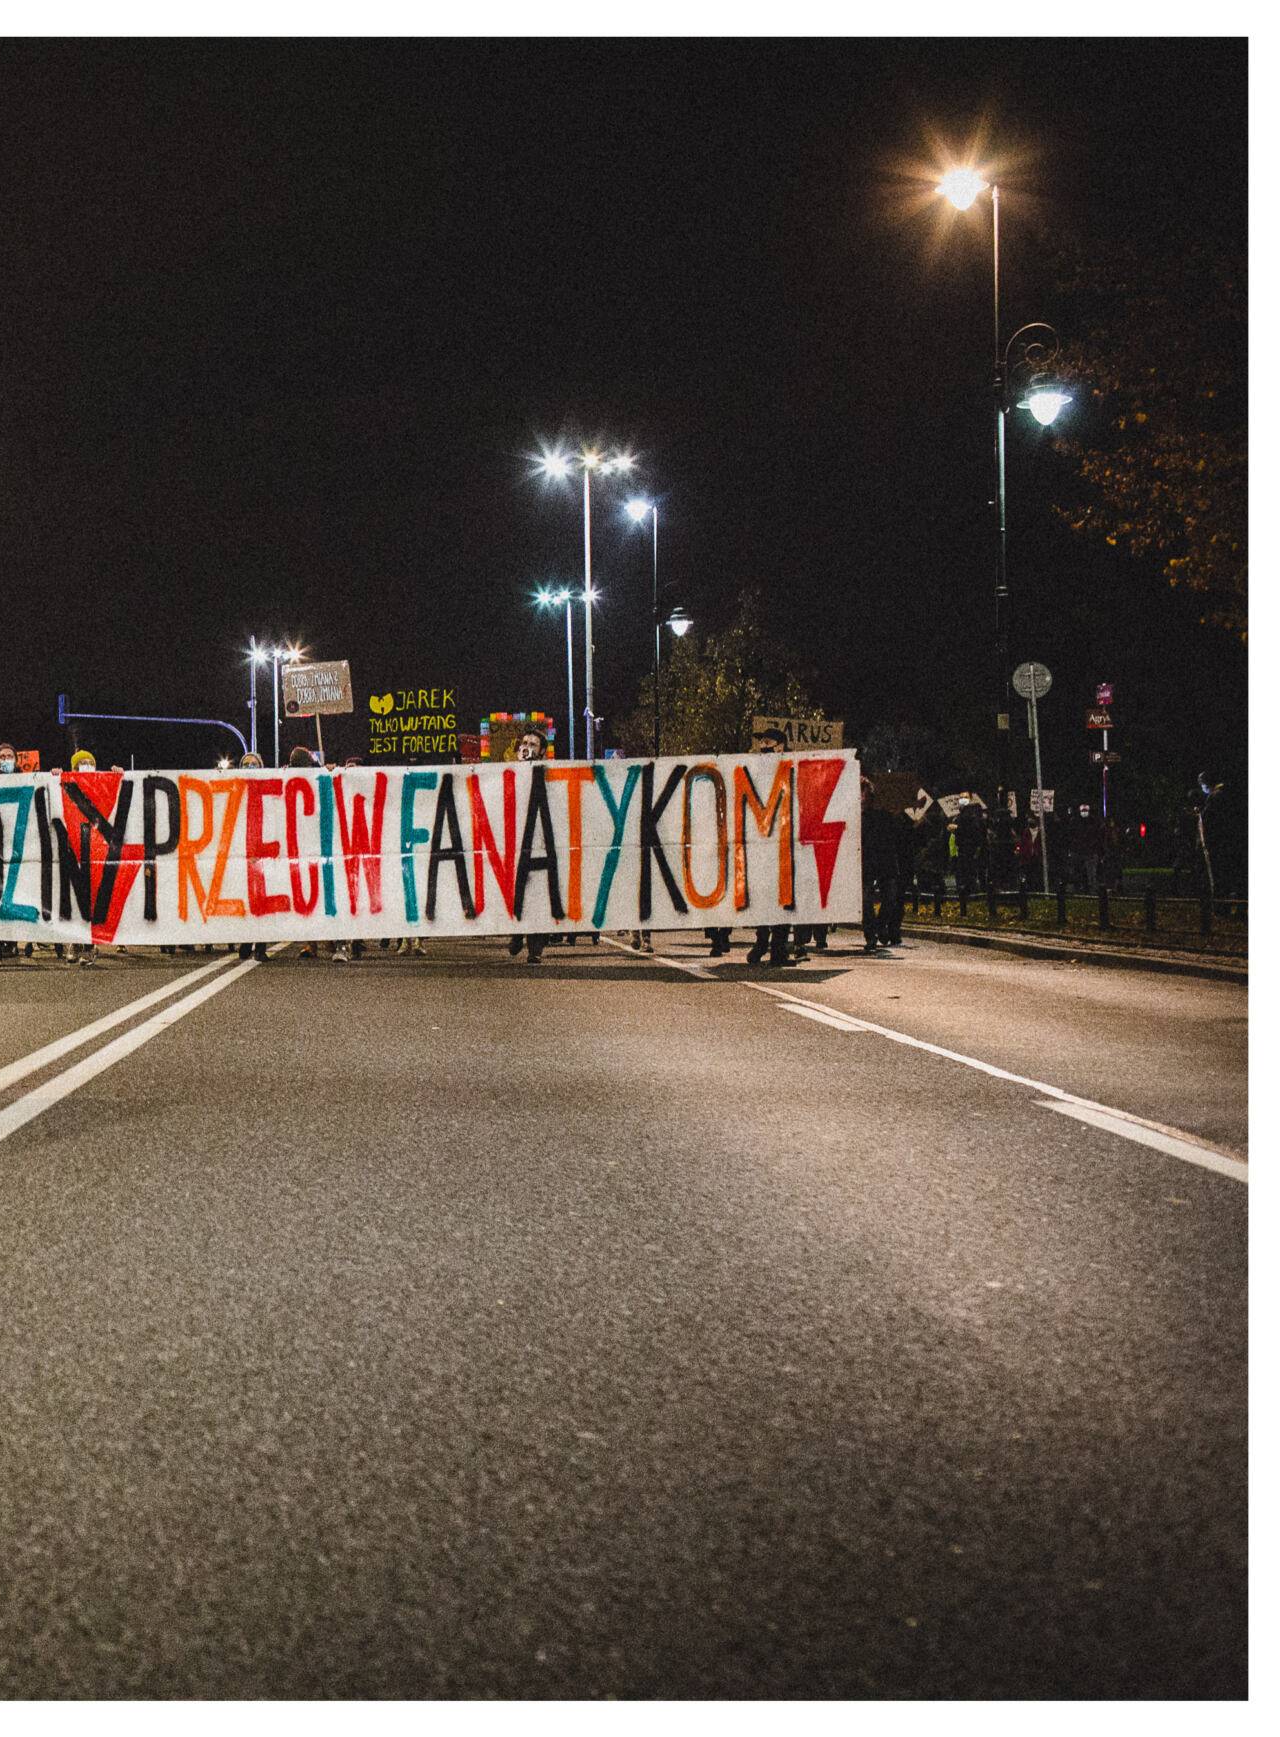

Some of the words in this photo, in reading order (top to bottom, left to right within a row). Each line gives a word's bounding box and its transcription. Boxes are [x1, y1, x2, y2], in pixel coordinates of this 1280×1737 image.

[396, 688, 456, 711] JAREK
[369, 717, 398, 733] TYLKO
[400, 713, 456, 732] WU-TANG
[370, 736, 398, 753] JEST
[402, 733, 457, 754] FOREVER
[143, 771, 387, 923] PRZECIW
[400, 760, 795, 929] FANATYKOM
